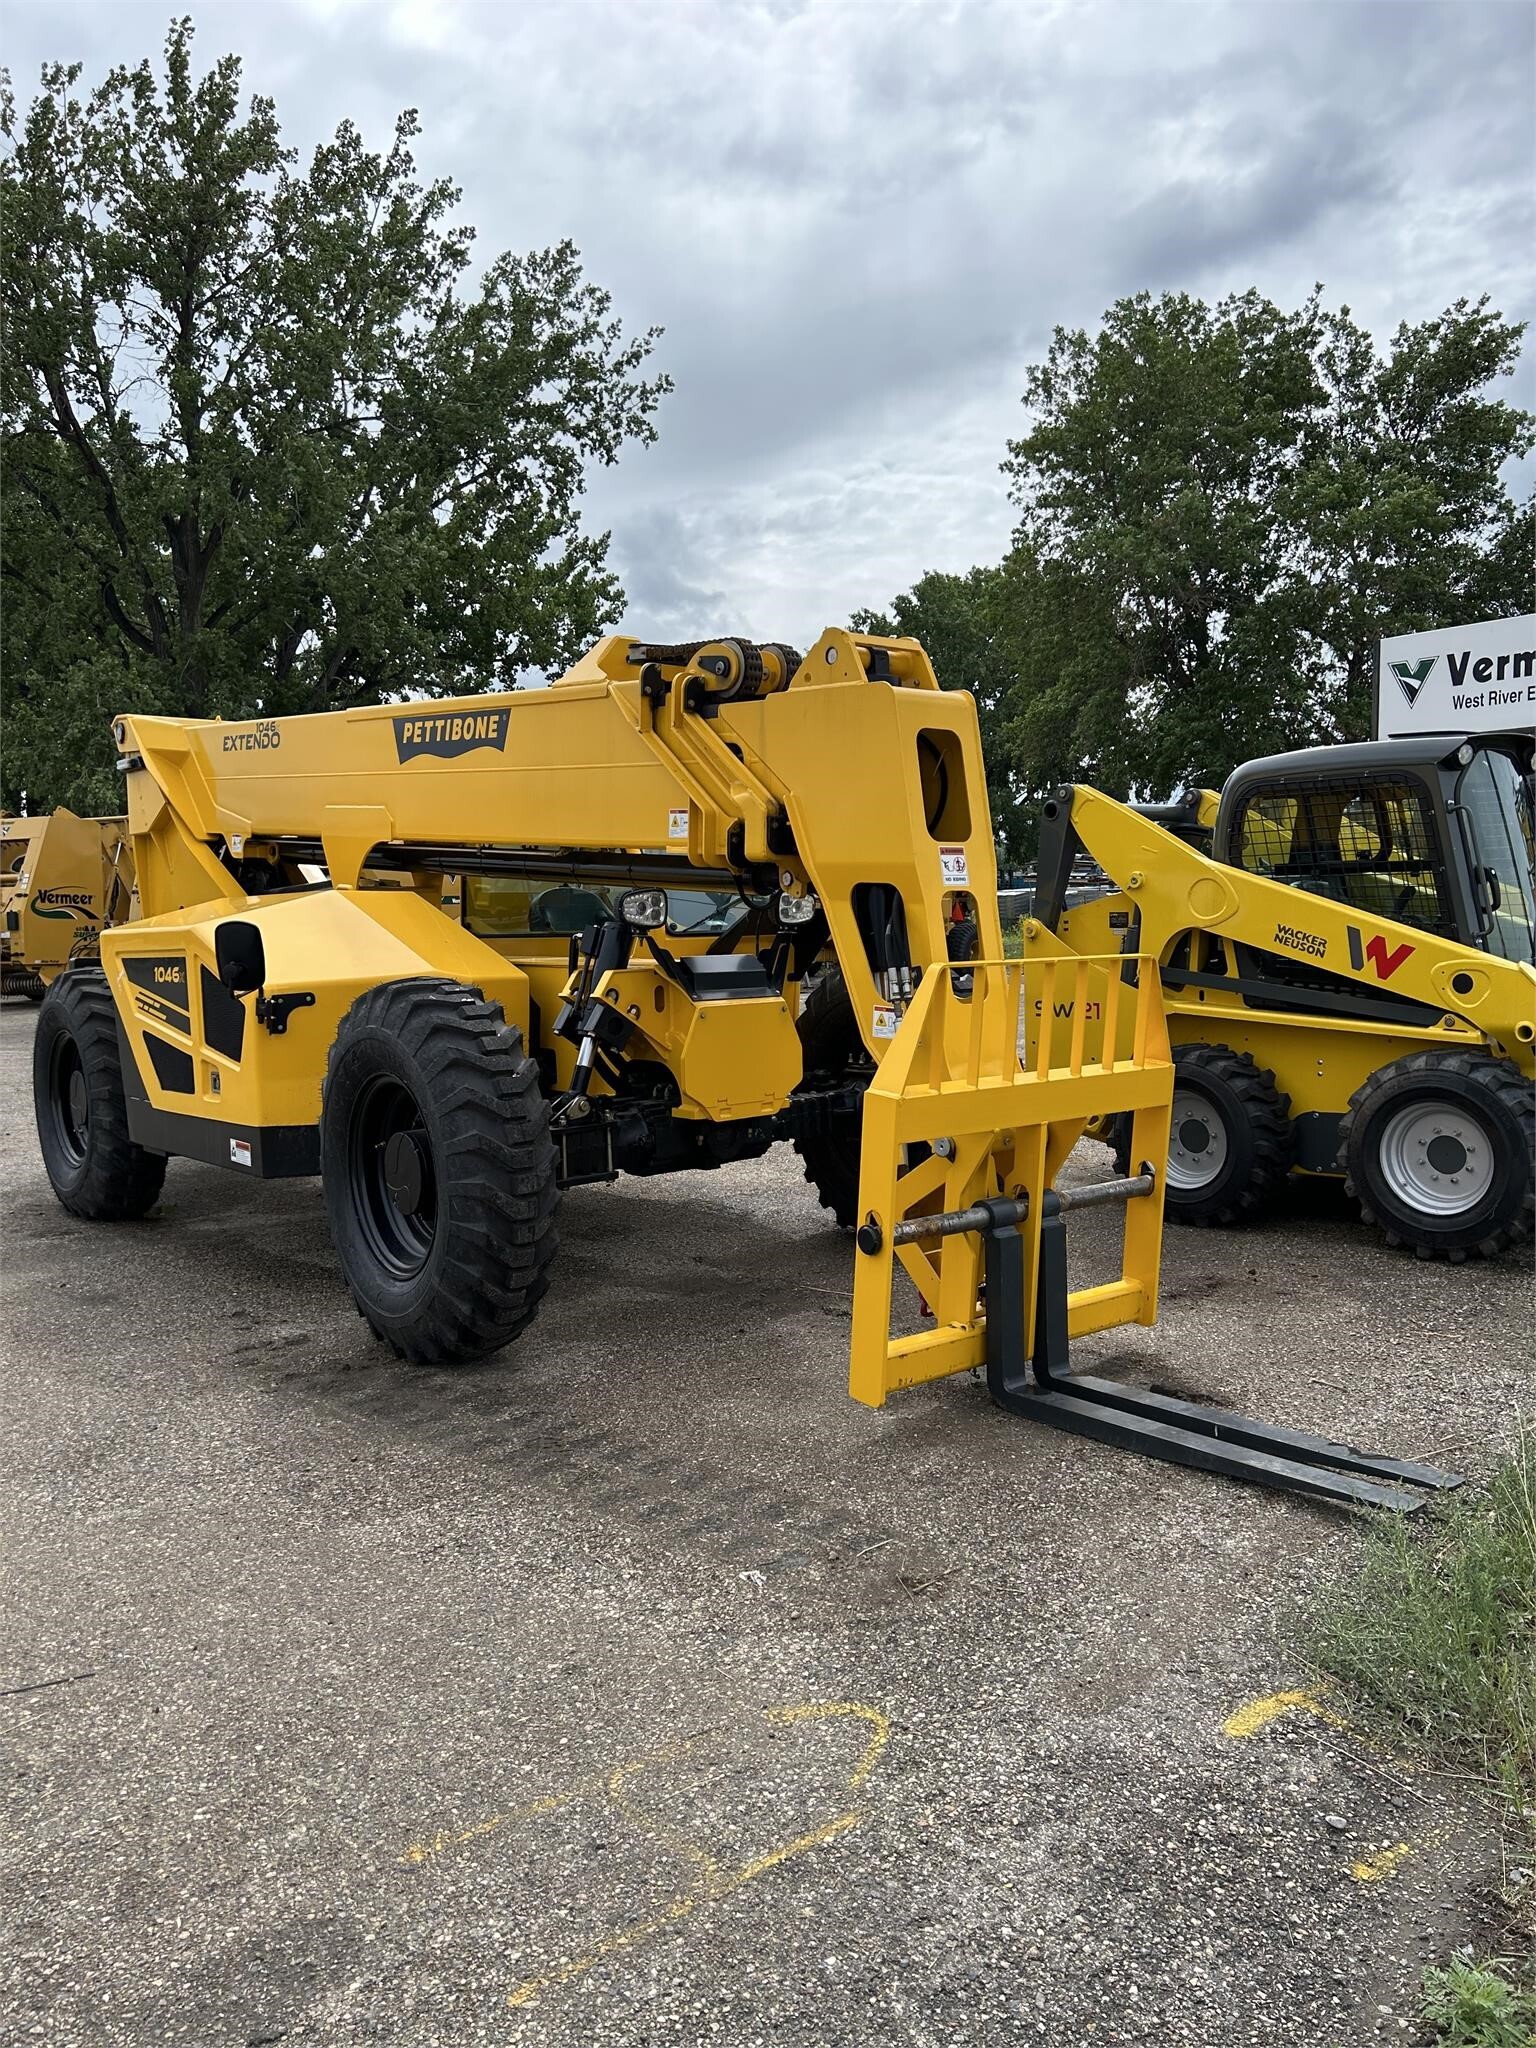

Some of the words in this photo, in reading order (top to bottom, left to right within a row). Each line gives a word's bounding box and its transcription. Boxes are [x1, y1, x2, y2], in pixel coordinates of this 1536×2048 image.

[1452, 692, 1485, 710] West
[1488, 690, 1523, 706] River
[402, 714, 500, 744] PETTIBONE
[223, 732, 280, 752] EXTENDO
[38, 889, 94, 905] Vermeer
[1274, 933, 1326, 959] NEUSON
[1277, 923, 1328, 949] WACKER
